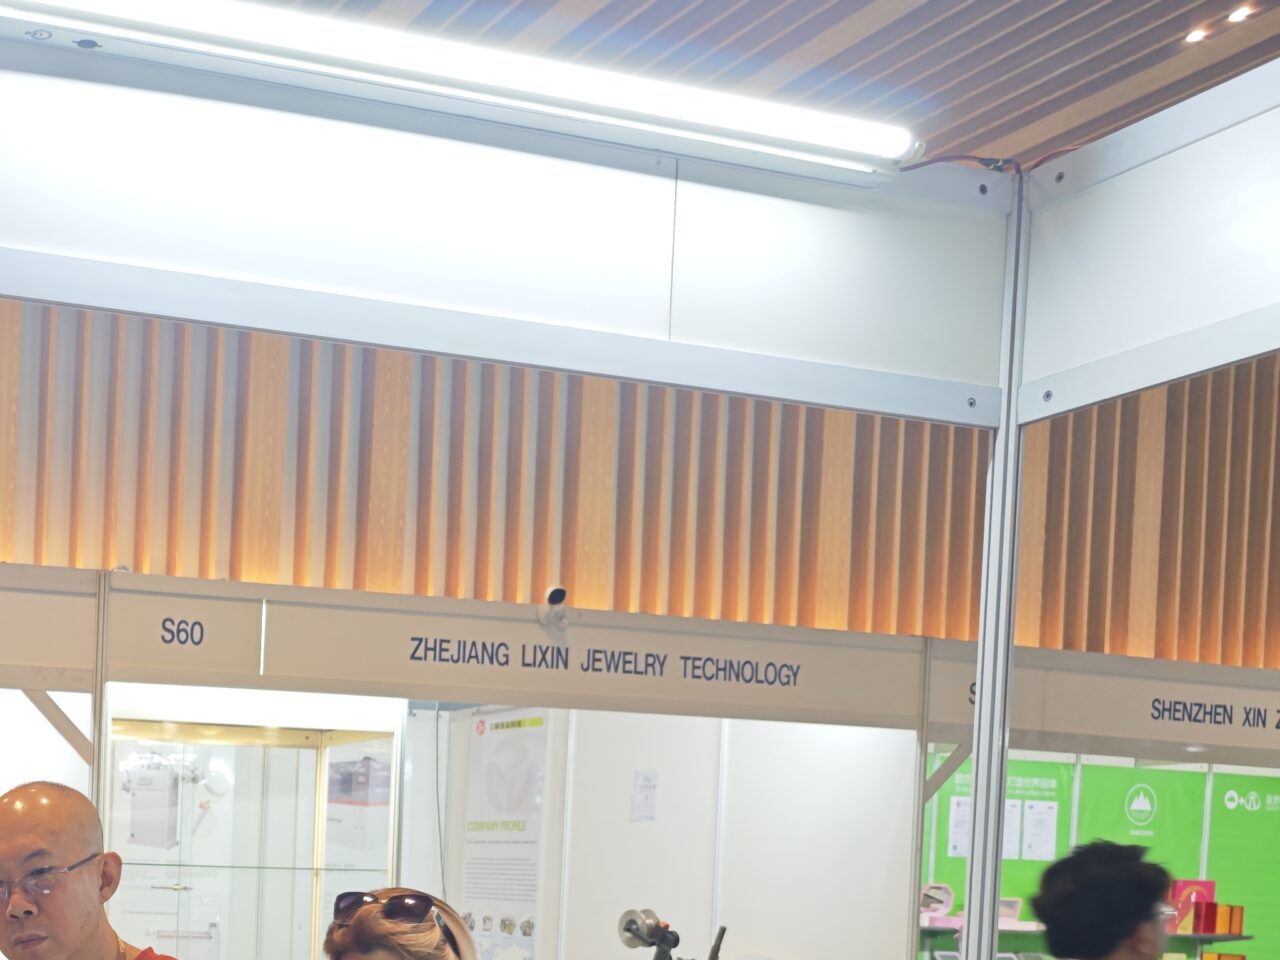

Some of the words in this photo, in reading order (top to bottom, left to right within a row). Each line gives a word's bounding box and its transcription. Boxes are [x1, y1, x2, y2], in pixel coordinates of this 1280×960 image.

[160, 617, 204, 646] S60
[409, 636, 510, 667] ZHEJIANG
[521, 644, 569, 670] LIXIN
[580, 648, 668, 677] JEWELRY
[679, 655, 801, 687] TECHNOLOGY
[1151, 698, 1233, 725] SHENZHEN
[1242, 706, 1267, 728] XIN
